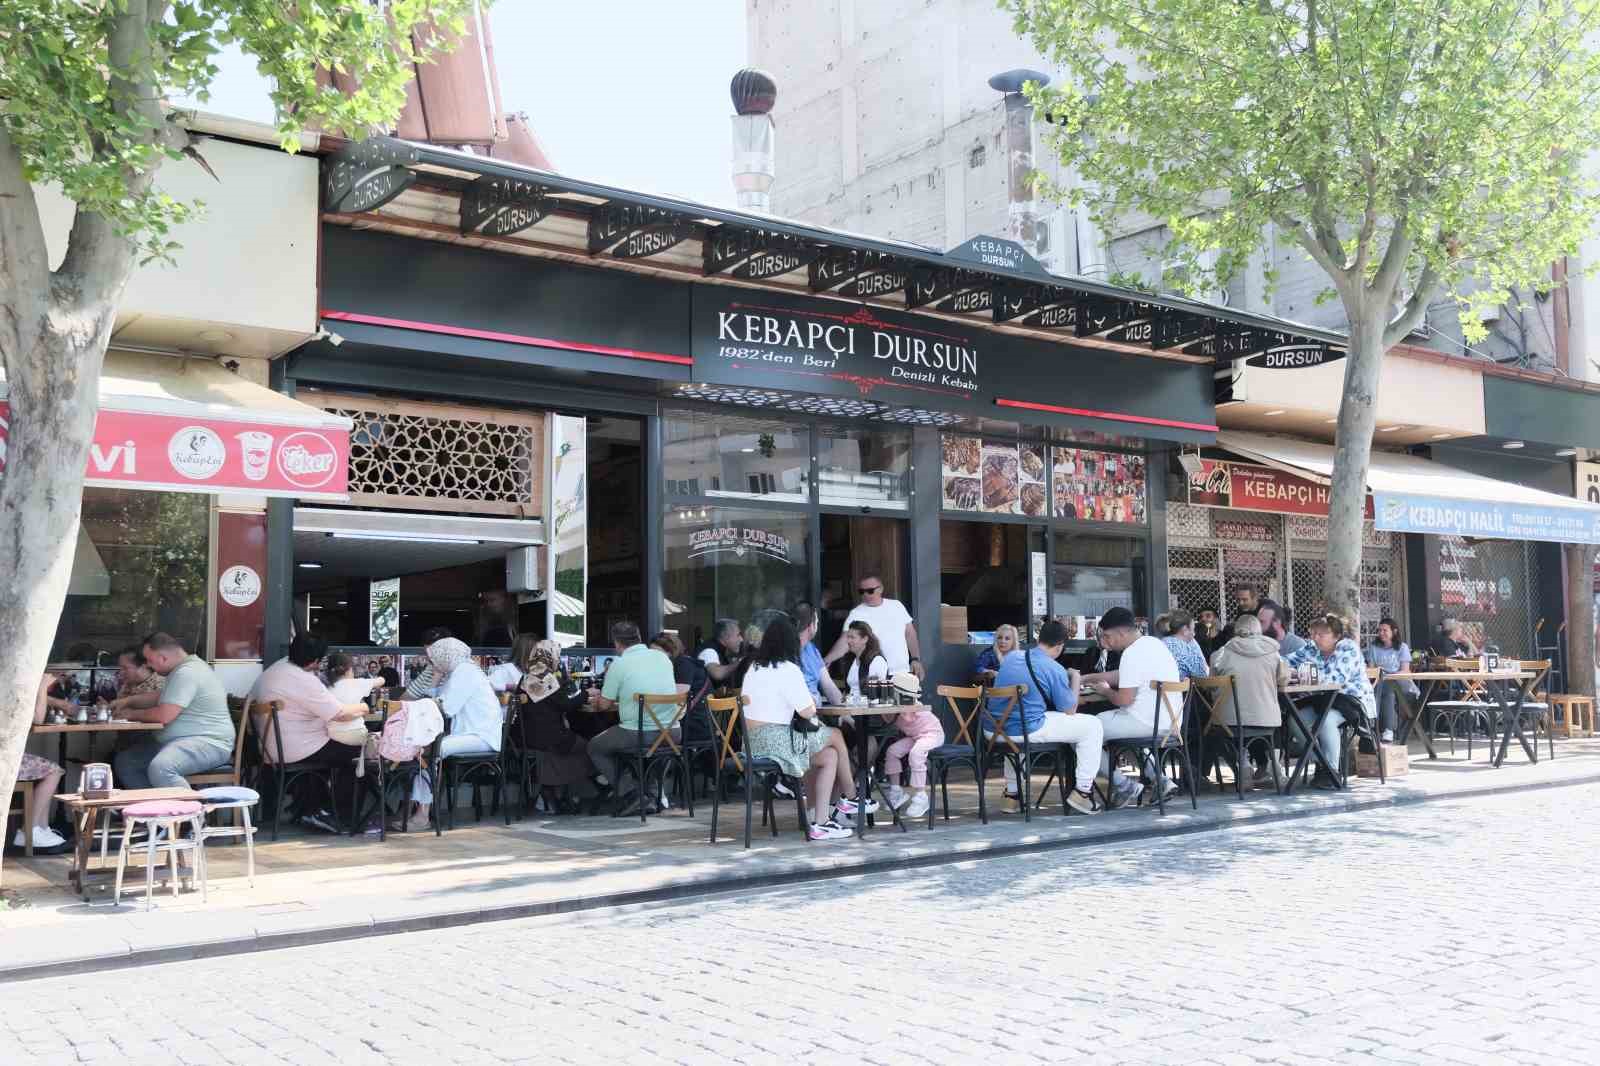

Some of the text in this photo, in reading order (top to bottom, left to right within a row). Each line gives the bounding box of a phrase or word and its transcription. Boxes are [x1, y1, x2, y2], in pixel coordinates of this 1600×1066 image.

[354, 175, 393, 208] DURSUN
[497, 208, 540, 233] DURSUN
[629, 236, 676, 256] DURSUN
[982, 253, 1015, 269] DURSUN
[718, 312, 977, 376] KEBAPÇI DURSUN
[803, 353, 837, 368] Beri
[1266, 350, 1323, 367] DURSUN
[891, 366, 978, 392] Denizli Kebabı
[1244, 480, 1313, 507] KEBAPÇI
[1408, 505, 1466, 533] KEBAPÇI
[1469, 507, 1505, 532] HALİL
